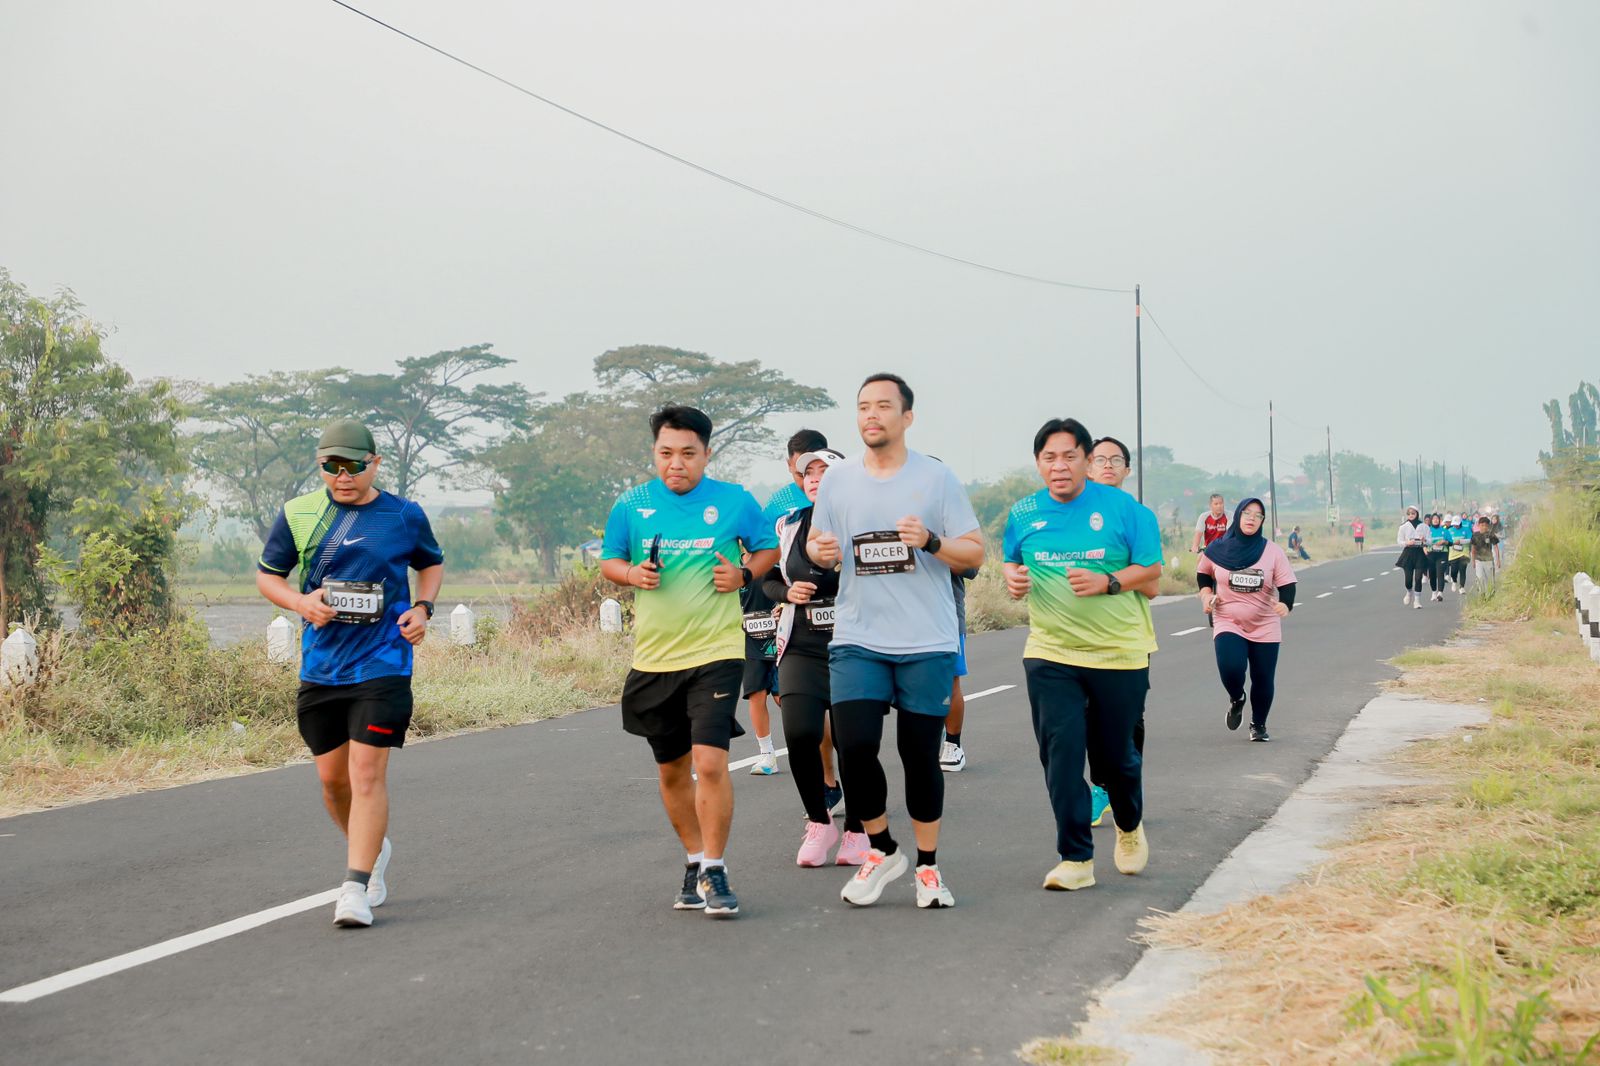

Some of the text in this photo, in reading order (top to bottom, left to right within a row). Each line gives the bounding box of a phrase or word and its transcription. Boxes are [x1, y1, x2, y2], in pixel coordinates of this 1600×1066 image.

[642, 538, 713, 549] DEANGGU RUN
[864, 546, 905, 558] PACER
[1034, 551, 1084, 560] DELANGGU
[1234, 576, 1258, 585] 00106
[333, 597, 371, 609] 00131
[748, 620, 773, 629] 00159
